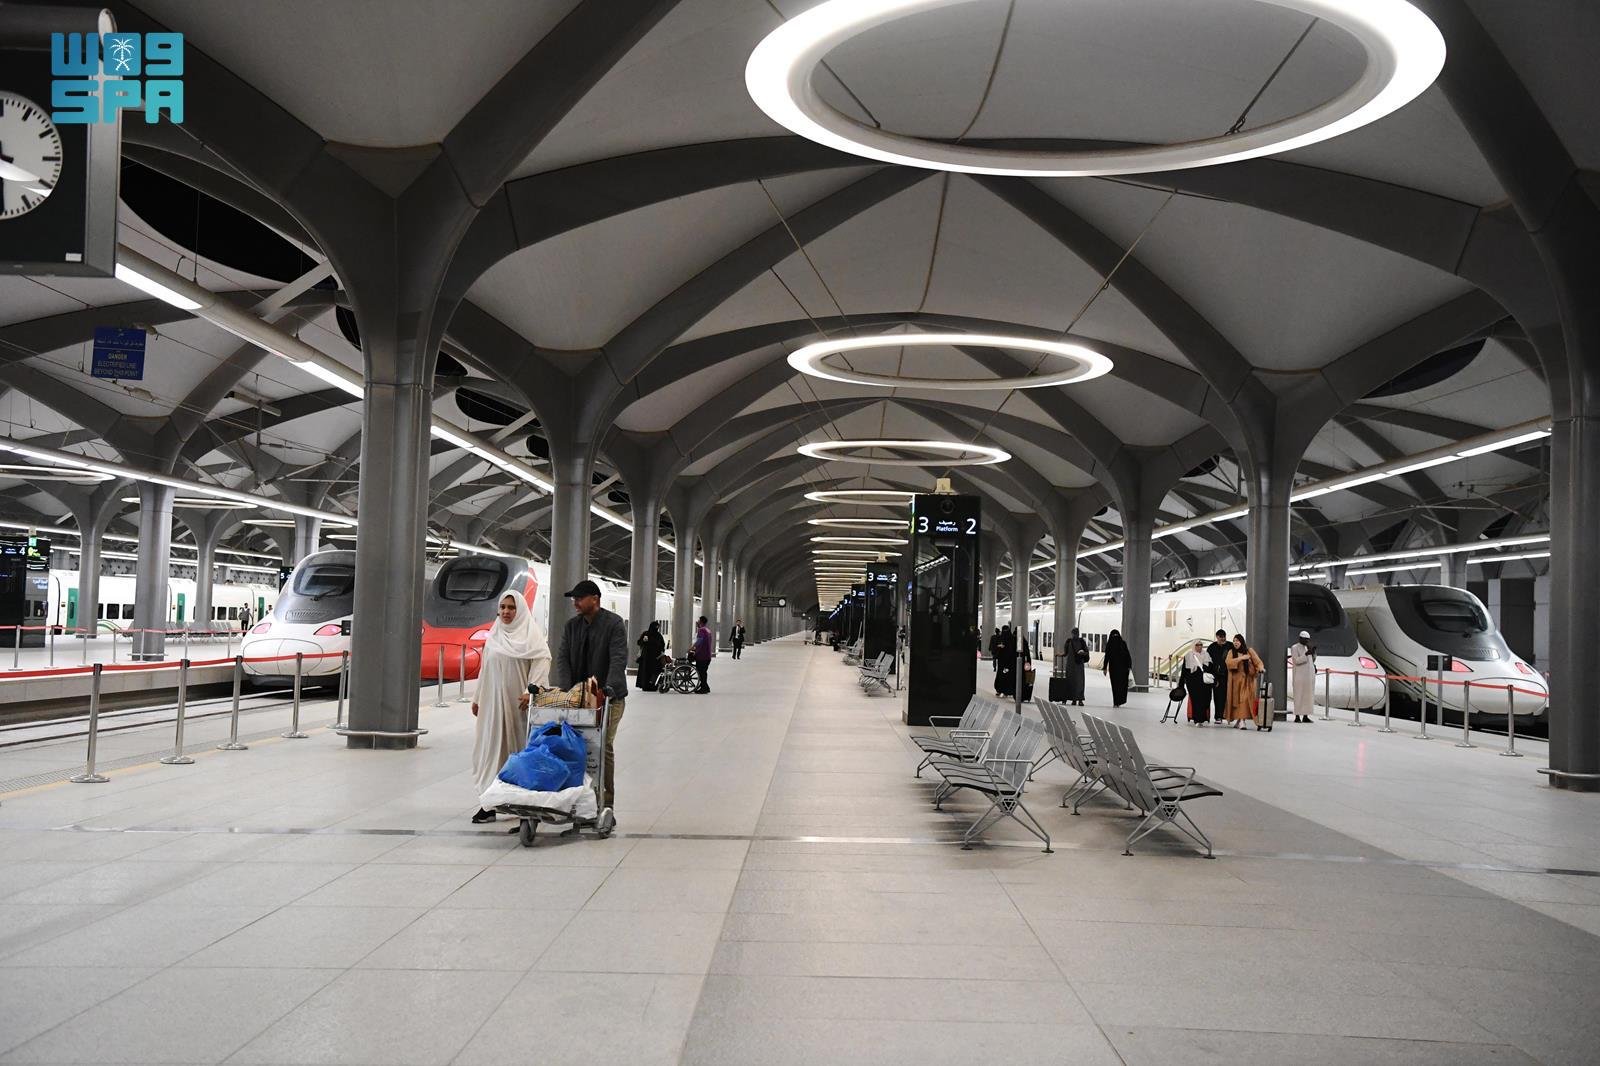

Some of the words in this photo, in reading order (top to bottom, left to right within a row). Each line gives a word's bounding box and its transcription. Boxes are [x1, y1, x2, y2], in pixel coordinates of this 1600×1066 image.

[918, 516, 929, 533] 3
[965, 518, 977, 534] 2
[19, 546, 26, 555] 4
[868, 572, 874, 582] 3
[890, 573, 898, 582] 2
